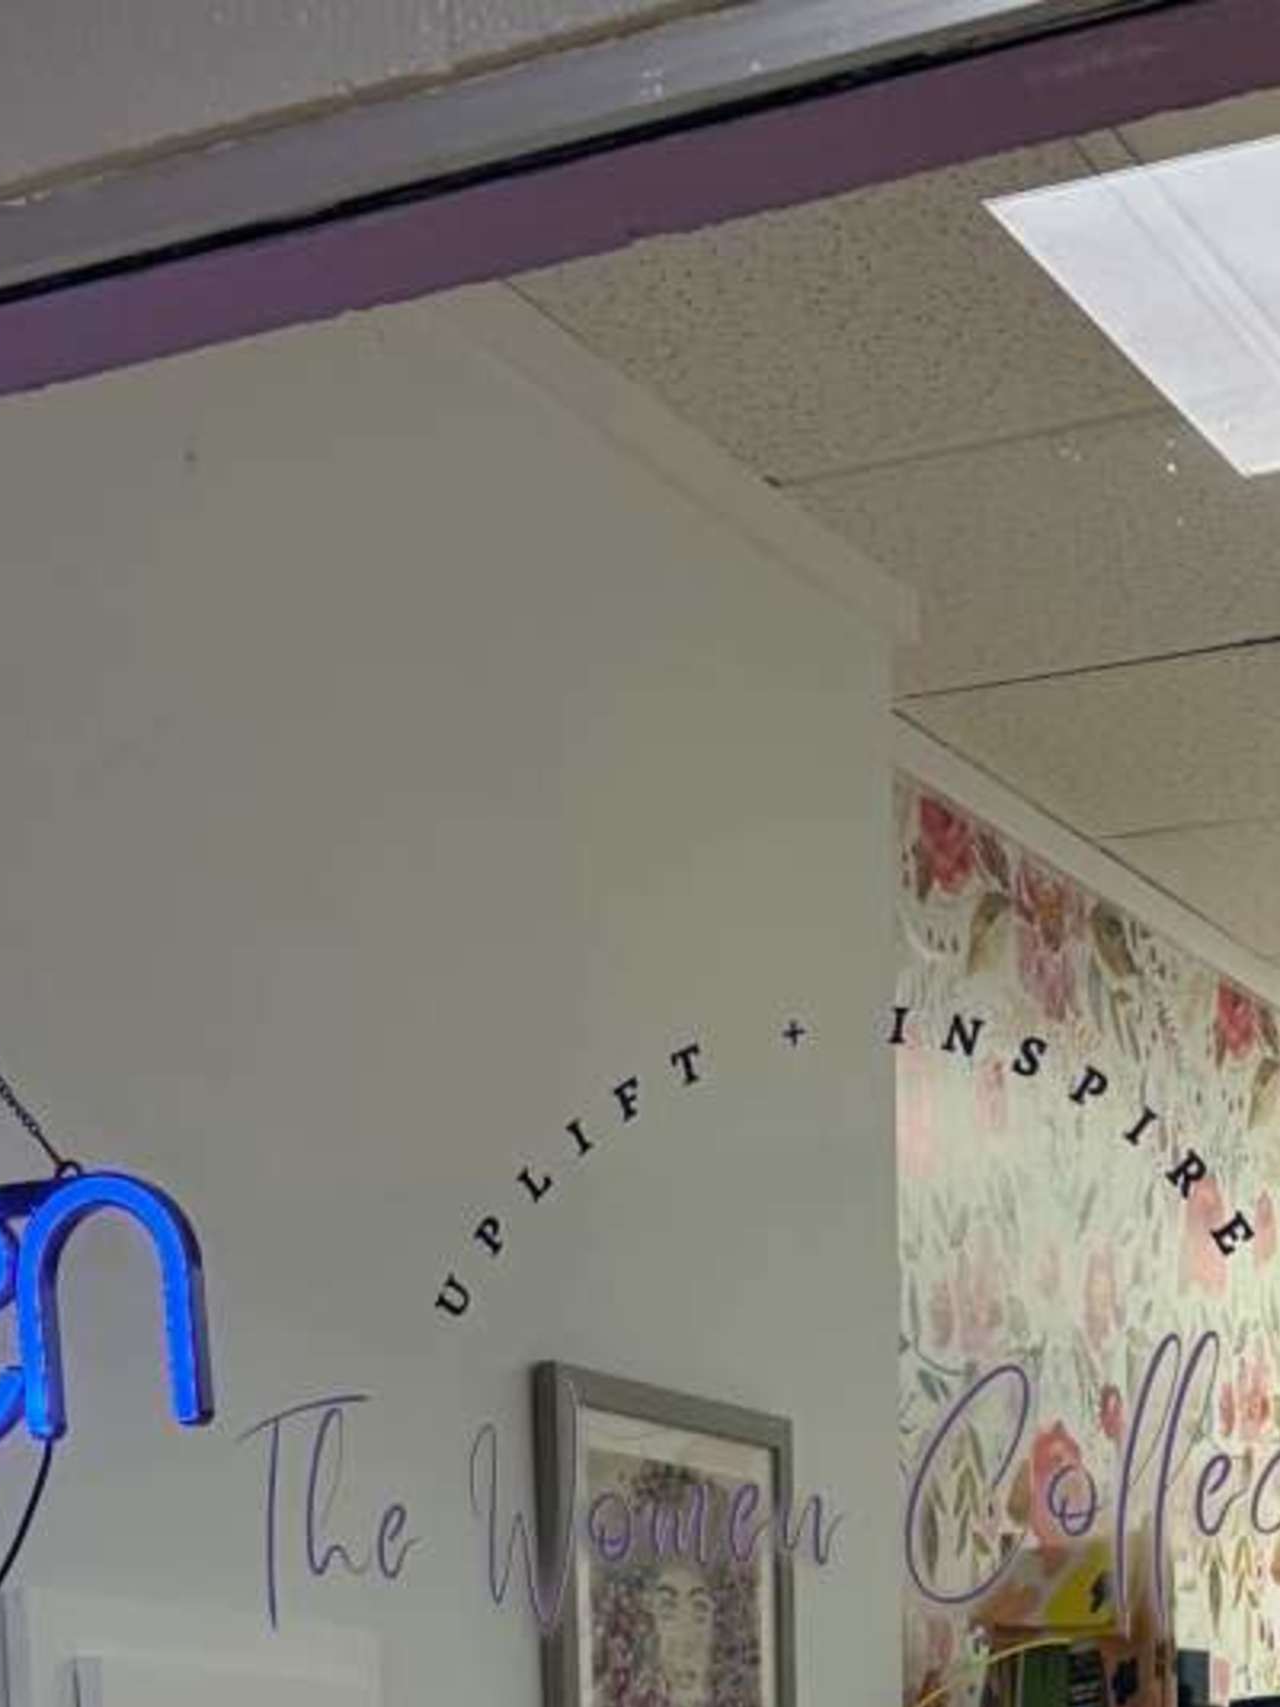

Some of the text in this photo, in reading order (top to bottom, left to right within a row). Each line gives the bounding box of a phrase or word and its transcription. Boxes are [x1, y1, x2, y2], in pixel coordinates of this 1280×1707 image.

[433, 1042, 703, 1322] UPLIFT
[886, 1005, 1255, 1258] INSPIRE
[235, 1393, 425, 1630] The
[469, 1383, 842, 1638] Women
